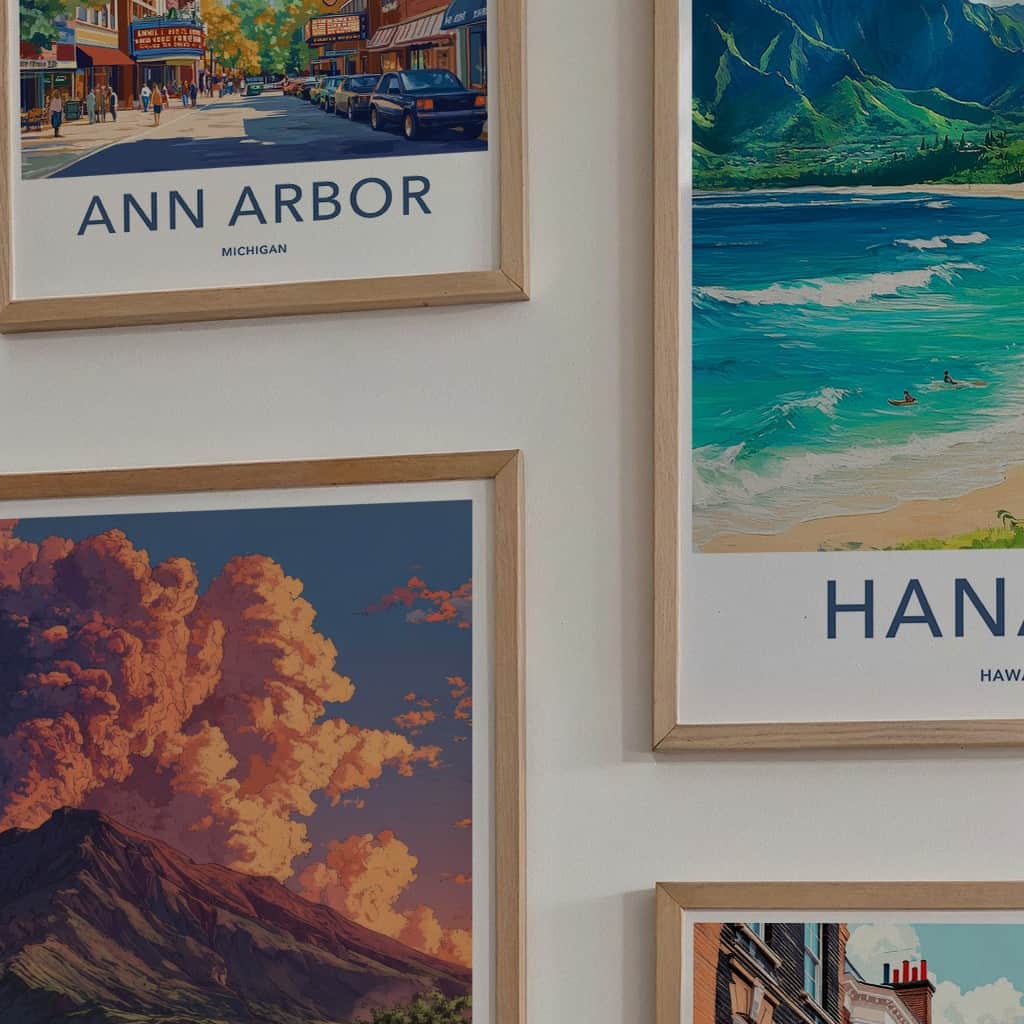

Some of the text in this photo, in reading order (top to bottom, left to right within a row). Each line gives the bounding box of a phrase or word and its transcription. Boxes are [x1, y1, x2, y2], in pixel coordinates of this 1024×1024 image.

[77, 175, 432, 236] ANN ARBOR
[221, 243, 287, 257] MICHIGAN
[826, 577, 1024, 640] HAN
[980, 668, 1024, 682] HAW
